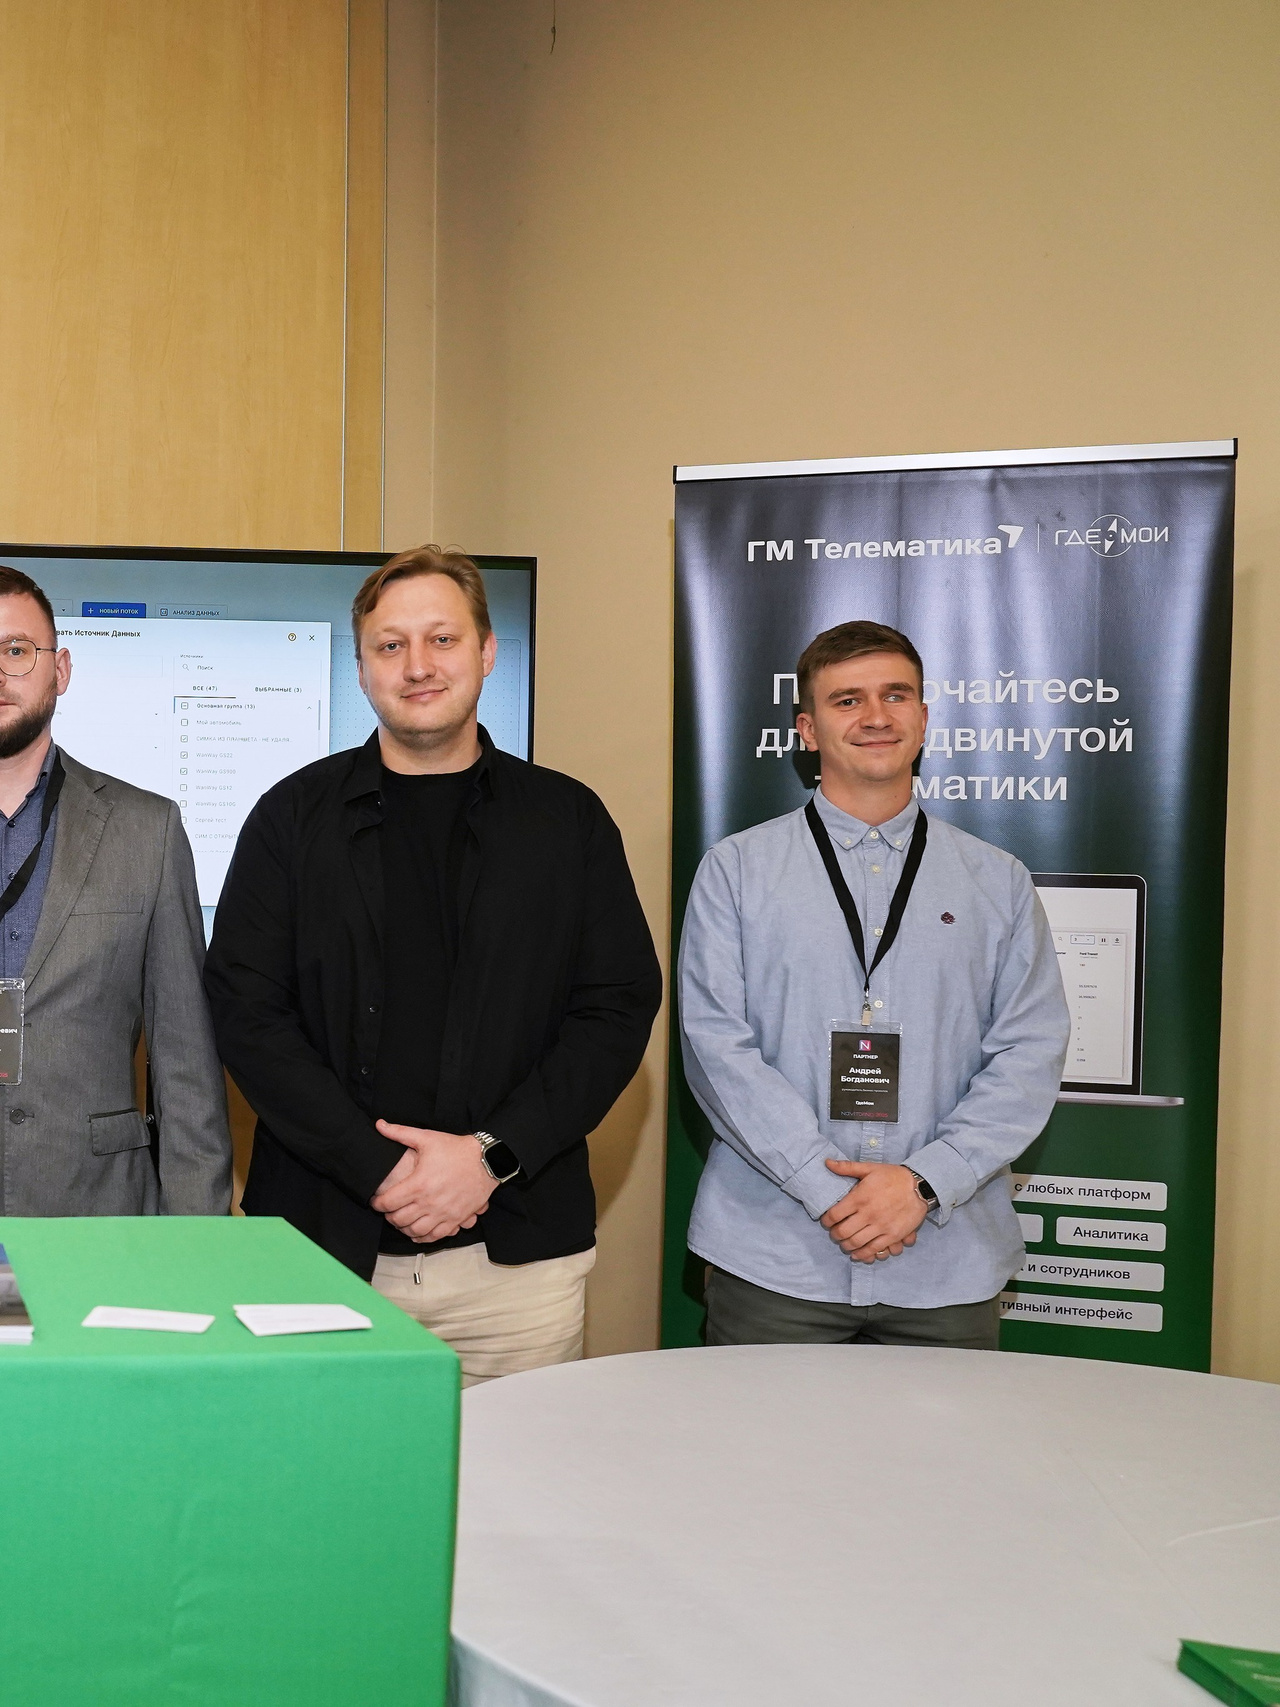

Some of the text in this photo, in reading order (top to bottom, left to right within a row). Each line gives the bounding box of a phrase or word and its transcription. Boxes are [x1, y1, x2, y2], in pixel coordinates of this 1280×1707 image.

[1055, 526, 1169, 546] ГДЕ МОИ
[747, 537, 1002, 562] ГМ Телематика
[756, 728, 807, 758] дл
[849, 1067, 882, 1075] Андрей
[840, 1076, 890, 1084] Богданович
[1014, 1183, 1151, 1202] с любых платформ
[1073, 1226, 1149, 1242] Аналитика
[1028, 1264, 1036, 1272] и
[1040, 1264, 1131, 1280] сотрудников
[1055, 1306, 1133, 1321] интерфейс
